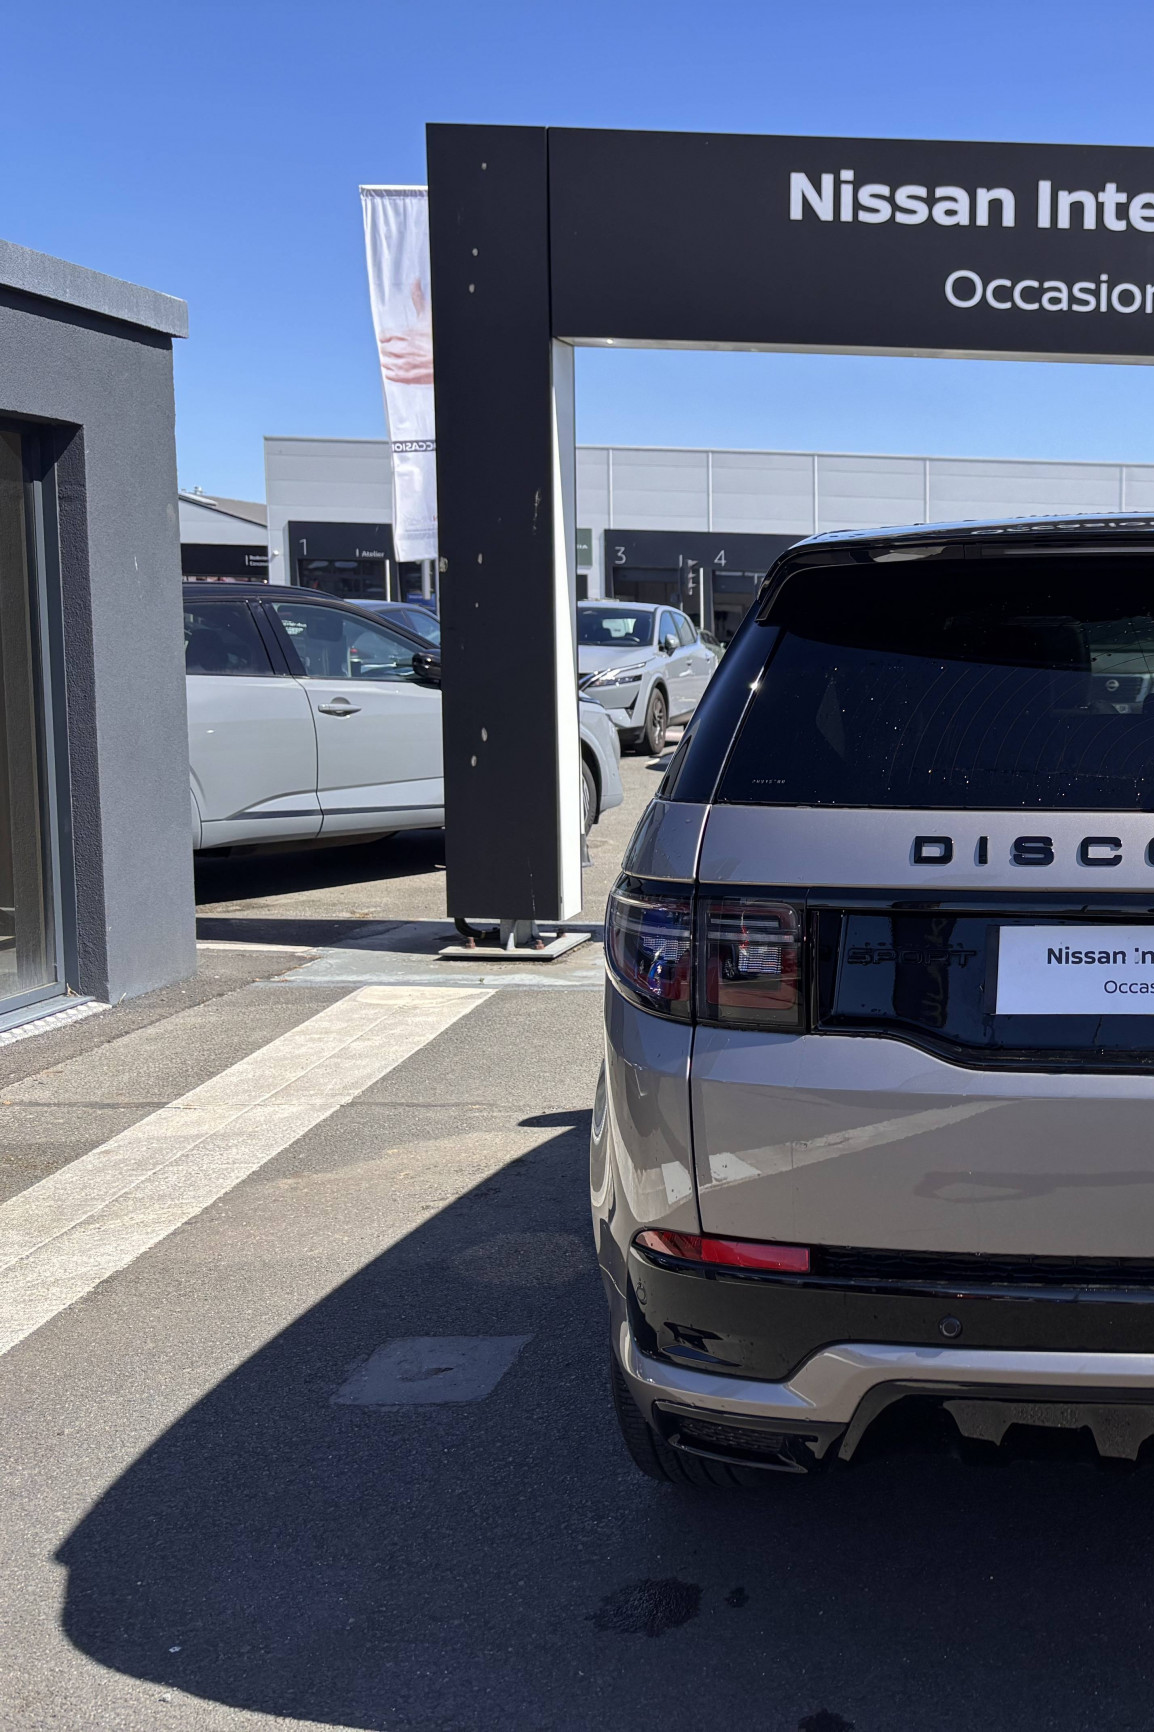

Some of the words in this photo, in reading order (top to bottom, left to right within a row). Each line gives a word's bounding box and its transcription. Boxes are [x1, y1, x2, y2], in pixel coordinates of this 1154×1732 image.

[788, 168, 1016, 228] Nissan
[299, 538, 307, 556] 1
[361, 550, 385, 558] Atelier
[614, 546, 627, 565] 3
[713, 549, 727, 567] 4
[848, 948, 977, 968] SPORT
[1046, 946, 1127, 965] Nissan
